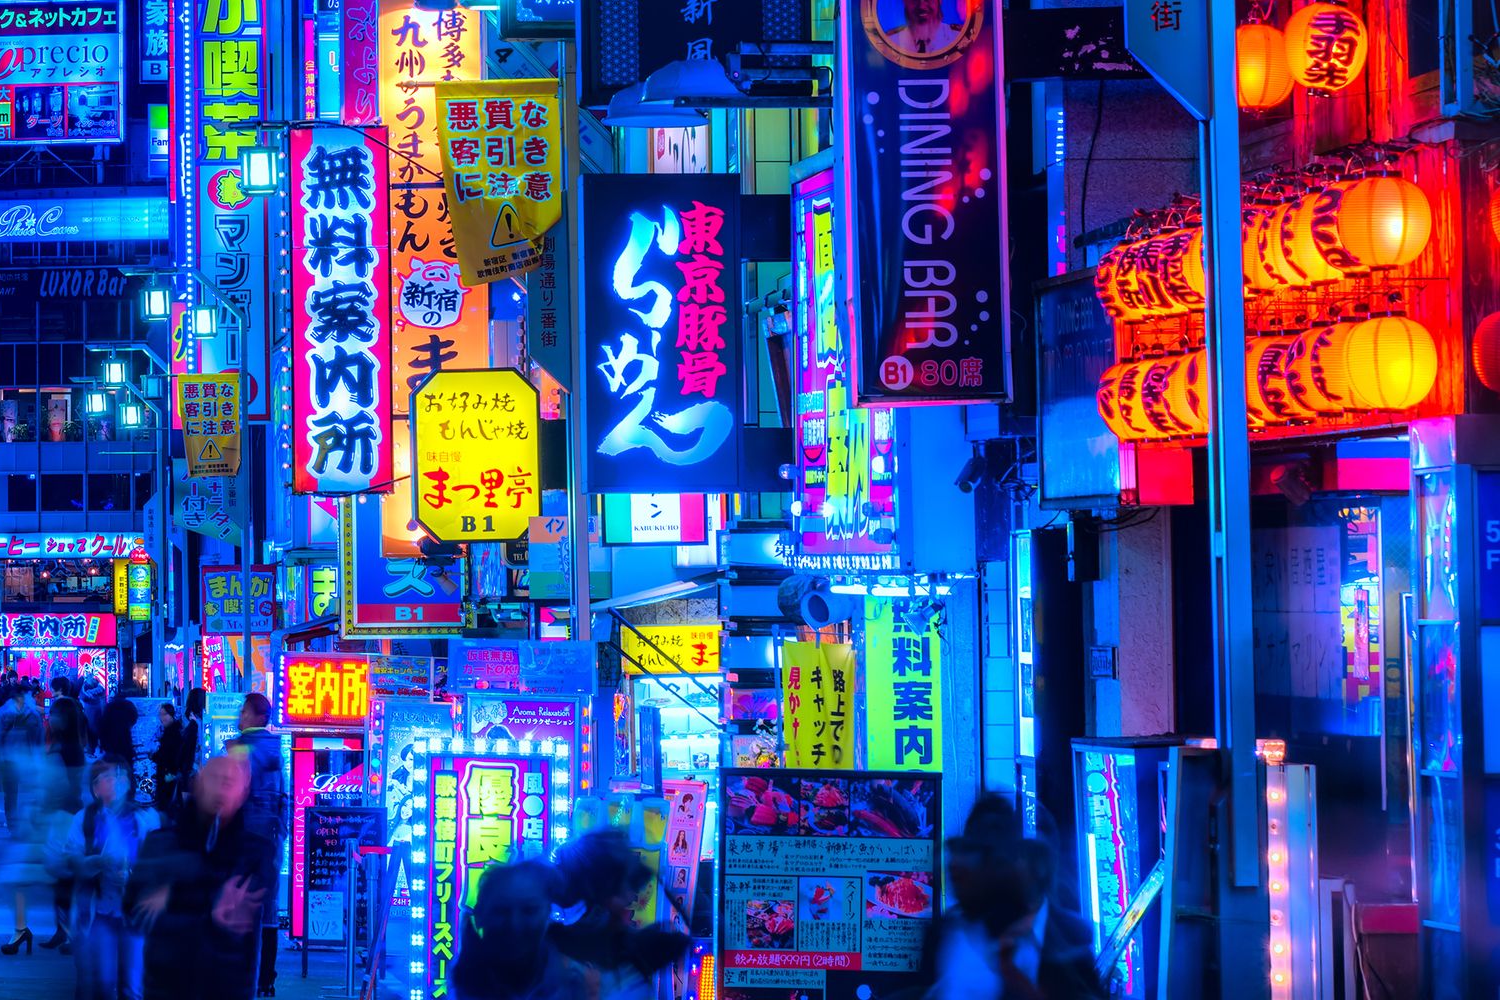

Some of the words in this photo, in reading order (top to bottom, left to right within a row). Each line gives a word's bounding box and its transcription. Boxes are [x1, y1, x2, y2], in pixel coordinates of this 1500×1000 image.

[1308, 11, 1359, 91] 手羽先
[30, 66, 106, 79] アプレシオ
[26, 115, 63, 129] ダーツ
[445, 99, 550, 132] 悪質な
[449, 135, 551, 169] 客引き
[897, 78, 956, 247] DINING
[454, 171, 553, 203] に注意
[39, 269, 95, 298] LUXOR
[96, 268, 128, 297] Bar
[304, 145, 379, 477] 無料案内所
[675, 200, 727, 399] 東京豚骨
[901, 259, 959, 350] BAR
[884, 361, 908, 383] B1
[920, 357, 984, 388] 80席
[183, 383, 235, 399] 悪質な
[423, 391, 516, 414] お好み焼
[184, 401, 235, 418] 客引き
[185, 419, 236, 436] に注意
[438, 418, 530, 441] もんじゃ焼
[425, 450, 463, 464] 味自慢
[422, 466, 533, 510] まつ里亭
[460, 515, 496, 533] B1
[633, 524, 680, 532] KABUKICHO
[91, 533, 127, 556] クール
[394, 606, 424, 622] B1
[467, 650, 514, 662] 仮眠無料
[287, 661, 369, 718] 案内所
[507, 717, 575, 726] アロマリラクゼーション
[512, 706, 536, 717] Aroma
[537, 705, 571, 718] Relaxation
